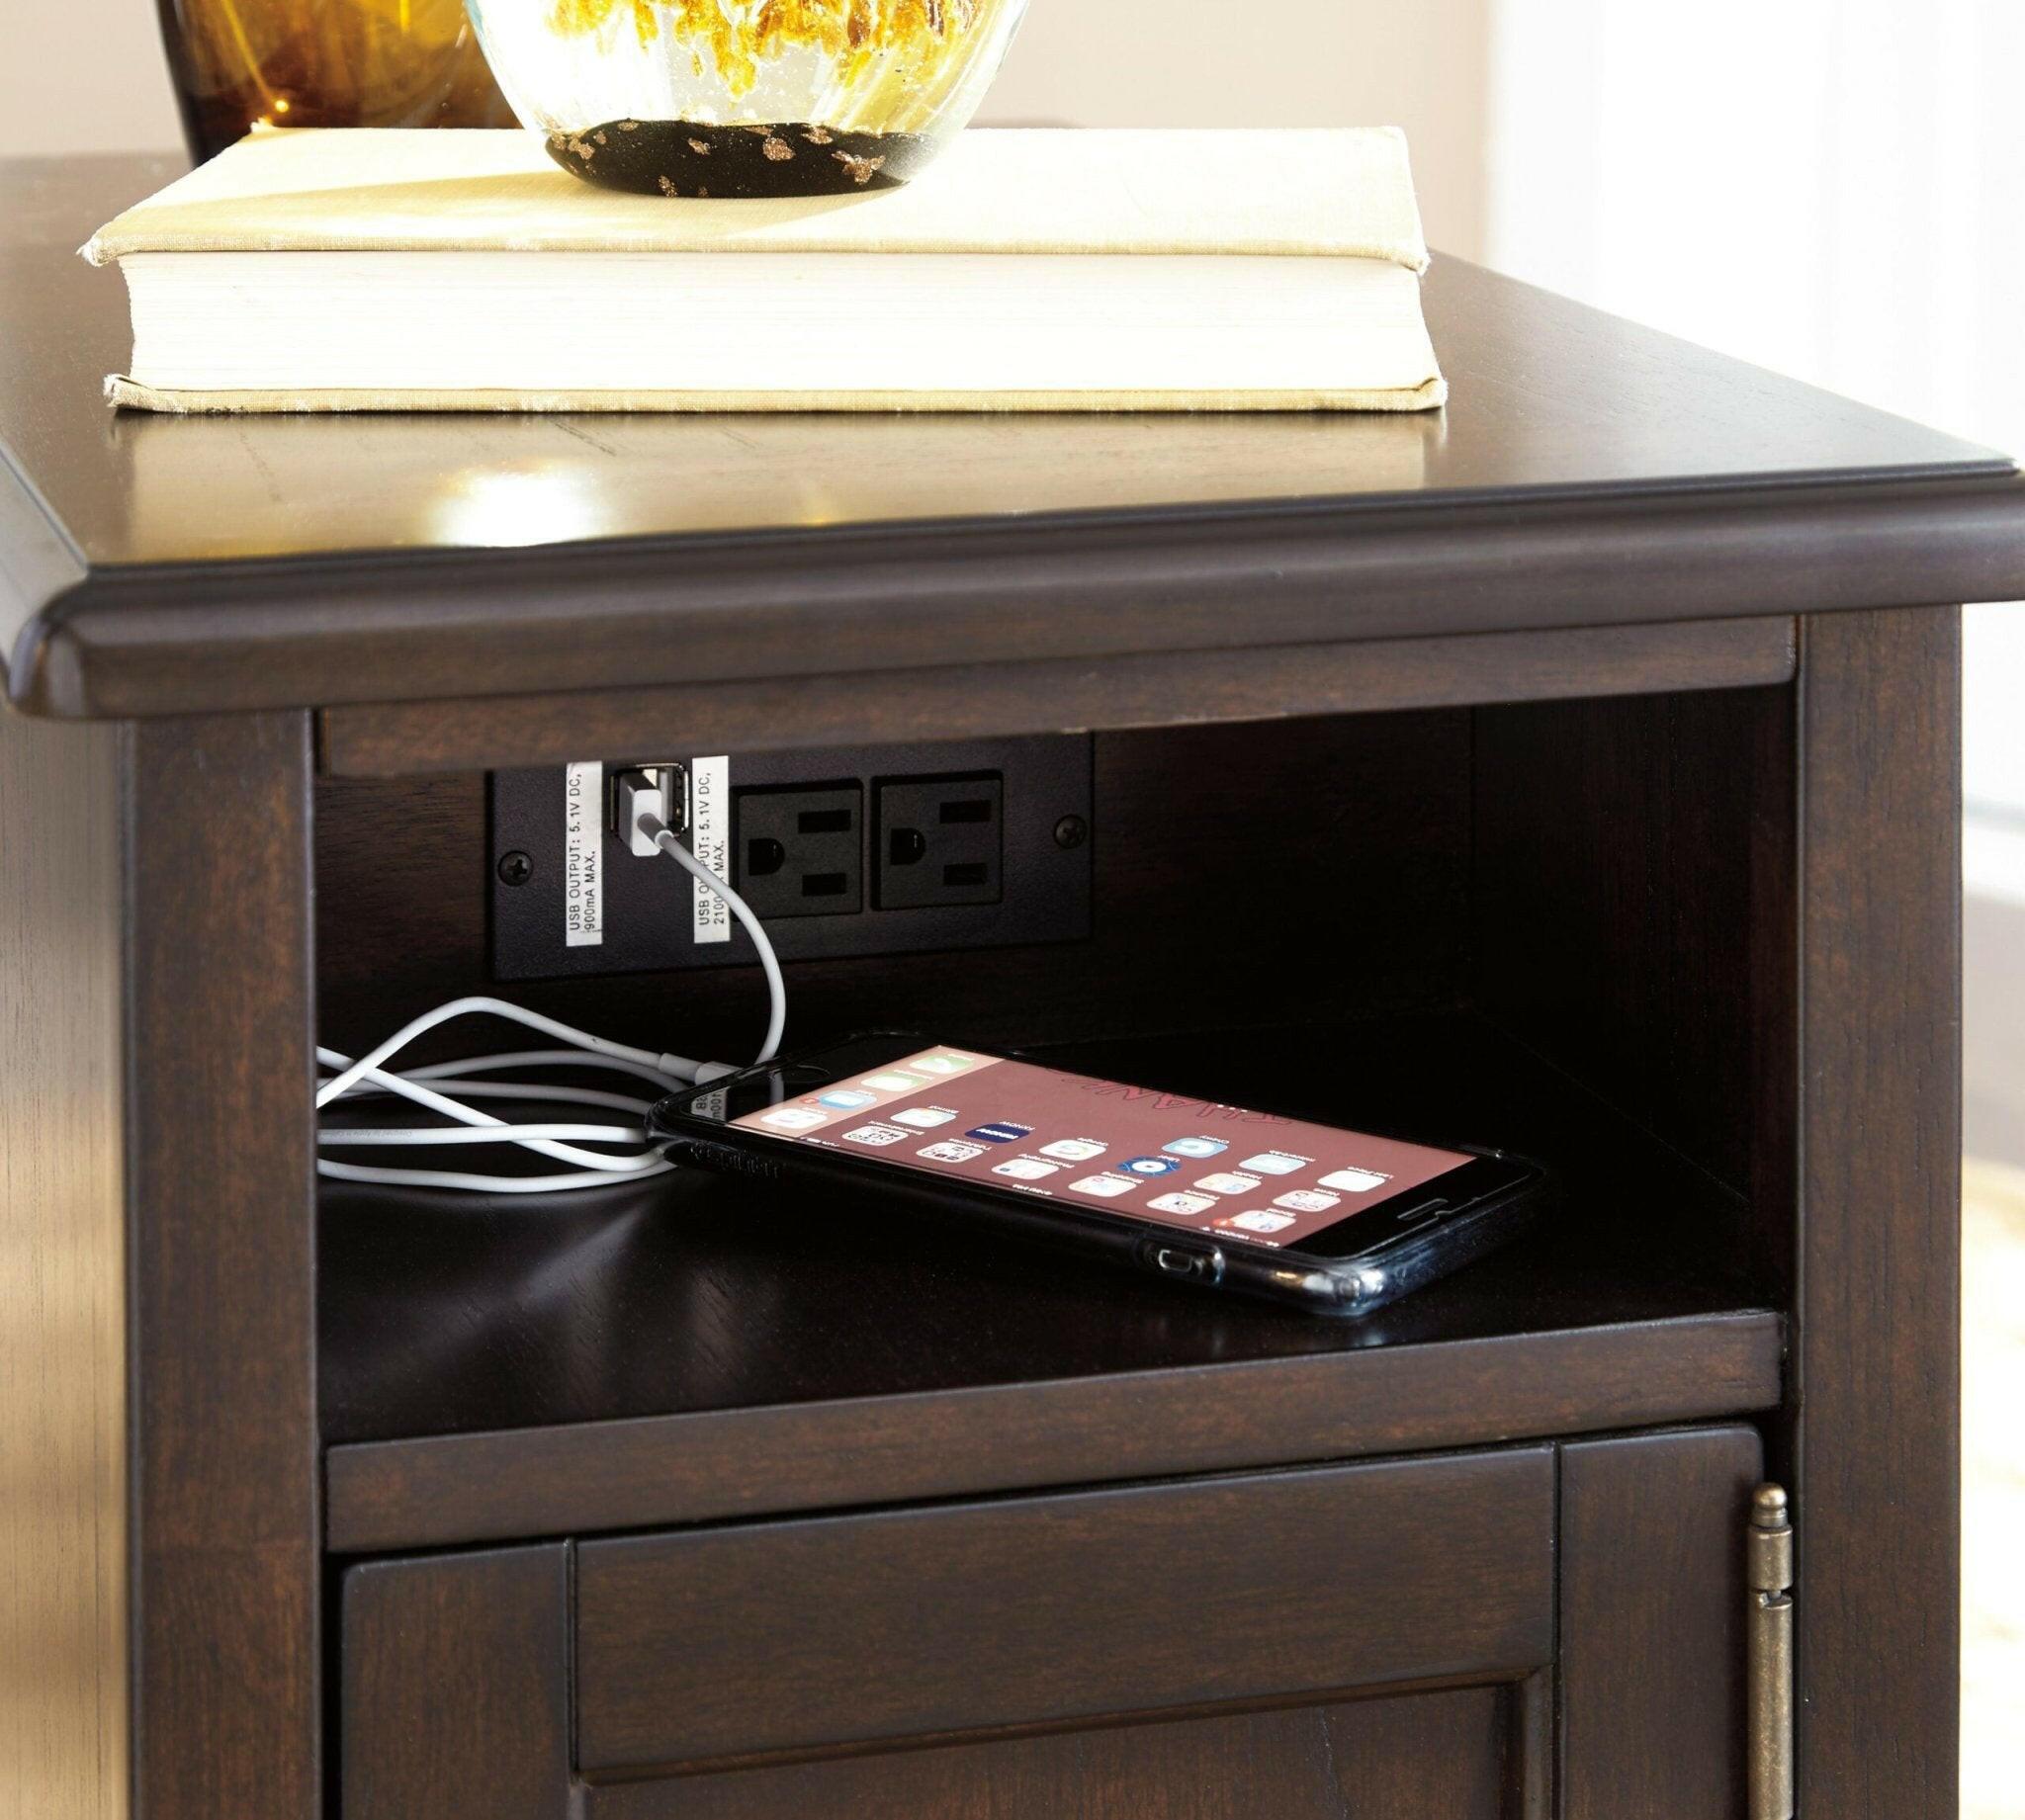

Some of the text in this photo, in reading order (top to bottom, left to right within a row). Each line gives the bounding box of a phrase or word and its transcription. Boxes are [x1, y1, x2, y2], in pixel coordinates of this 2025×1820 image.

[569, 773, 581, 797] DC,
[698, 772, 711, 795] DC,
[569, 839, 580, 899] OUTPUT:
[698, 836, 710, 895] OPUT:
[713, 840, 725, 871] MAX.
[583, 850, 595, 930] 900mA MAX.
[569, 904, 580, 931] USB
[698, 900, 710, 925] USB
